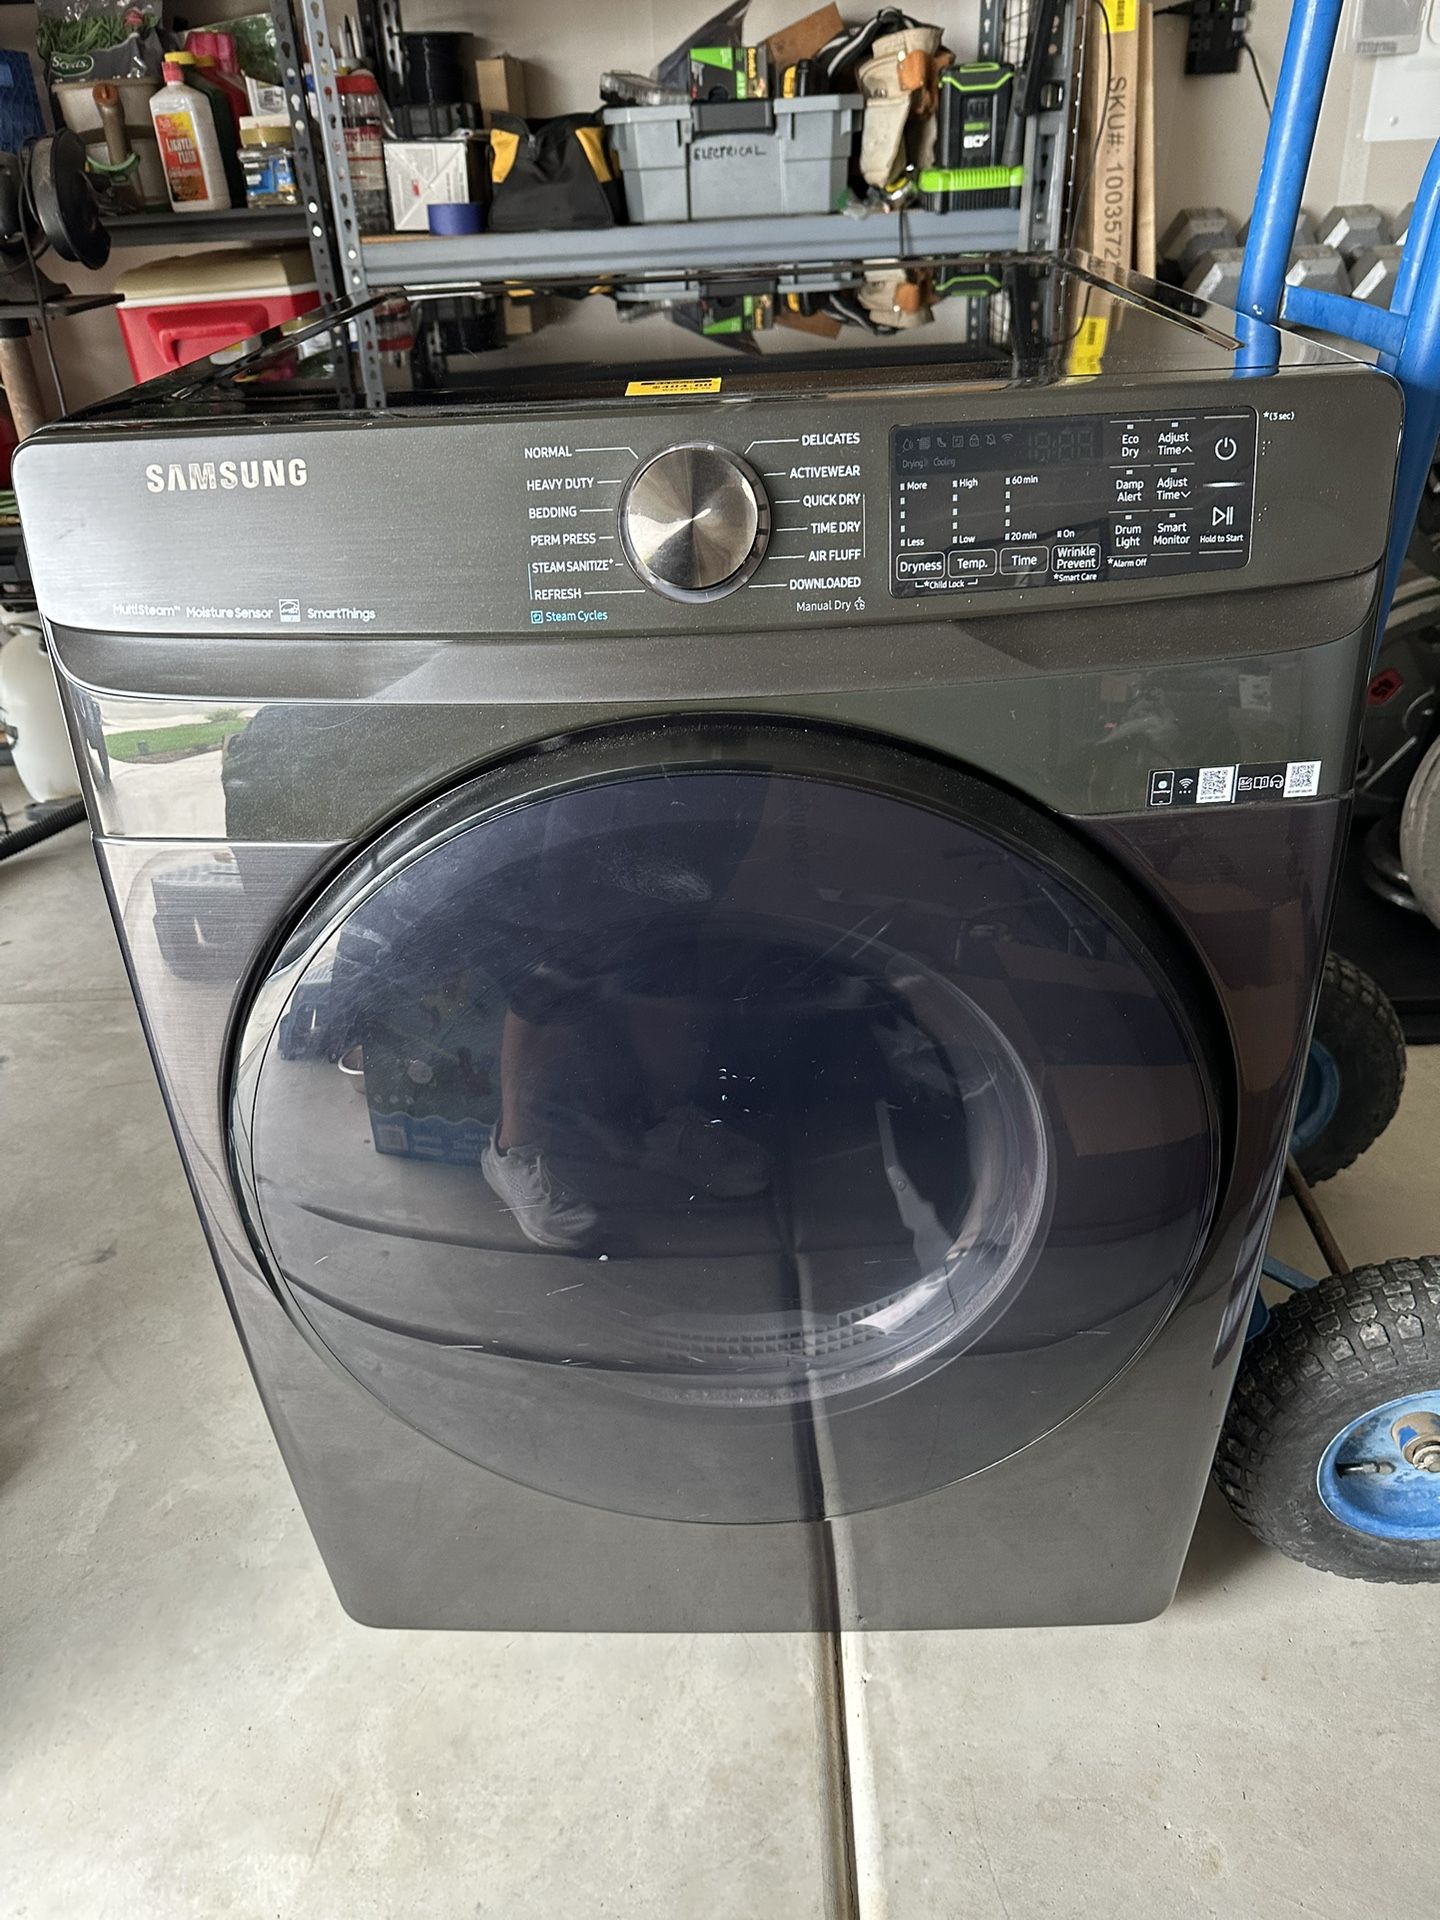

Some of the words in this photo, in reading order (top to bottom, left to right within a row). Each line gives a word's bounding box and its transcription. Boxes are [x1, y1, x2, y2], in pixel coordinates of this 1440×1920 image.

[694, 144, 767, 160] ELECTRICAL
[1103, 165, 1124, 266] 1003572
[801, 432, 860, 446] DELICATES
[1121, 434, 1139, 444] Eco
[1158, 432, 1189, 444] Adjust
[524, 446, 572, 459] NORMAL
[1121, 447, 1139, 458] Dry
[1158, 445, 1182, 455] Time
[902, 458, 924, 469] Drying
[933, 457, 956, 468] Cooling
[145, 458, 308, 493] SAMSUNG
[789, 465, 861, 479] ACTIVEWEAR
[526, 478, 563, 491] HEAVY
[565, 477, 594, 489] DUTY
[906, 481, 928, 490] More
[959, 479, 978, 490] High
[1011, 476, 1023, 485] 60
[1023, 475, 1039, 484] min
[1116, 479, 1144, 491] Damp
[1157, 477, 1188, 489] Adjust
[802, 494, 837, 508] QUICK
[838, 493, 861, 505] DRY
[1117, 491, 1142, 502] Alert
[1156, 490, 1181, 500] Time
[528, 506, 577, 519] BEDDING
[810, 522, 838, 534] TIME
[839, 521, 861, 533] DRY
[1063, 529, 1075, 538] On
[1115, 524, 1142, 535] Drum
[1157, 522, 1187, 533] Smart
[530, 534, 561, 546] PERM
[563, 533, 596, 545] PRESS
[959, 535, 976, 544] Low
[1011, 532, 1022, 541] 20
[1022, 531, 1038, 540] min
[1153, 534, 1191, 546] Monitor
[1200, 535, 1216, 543] Hold
[1217, 535, 1225, 543] to
[1226, 533, 1244, 542] Start
[907, 538, 925, 547] Less
[1115, 536, 1141, 549] Light
[808, 550, 827, 562] AIR
[829, 548, 861, 561] FLUFF
[1057, 546, 1096, 558] Wrinkle
[957, 557, 988, 570] Temp.
[1011, 554, 1038, 566] Time
[1056, 557, 1096, 570] Prevent
[1135, 557, 1148, 567] Off
[532, 561, 566, 574] STEAM
[900, 559, 942, 574] Dryness
[1081, 573, 1097, 581] Care
[789, 577, 861, 590] DOWNLOADED
[948, 579, 965, 588] Lock
[534, 588, 582, 600] REFRESH
[186, 605, 234, 619] Moisture
[235, 607, 274, 619] Sensor
[796, 600, 832, 612] Manual
[834, 600, 851, 612] Dry
[307, 607, 377, 622] SmartThings
[545, 611, 576, 622] Steam
[577, 610, 608, 623] Cycles
